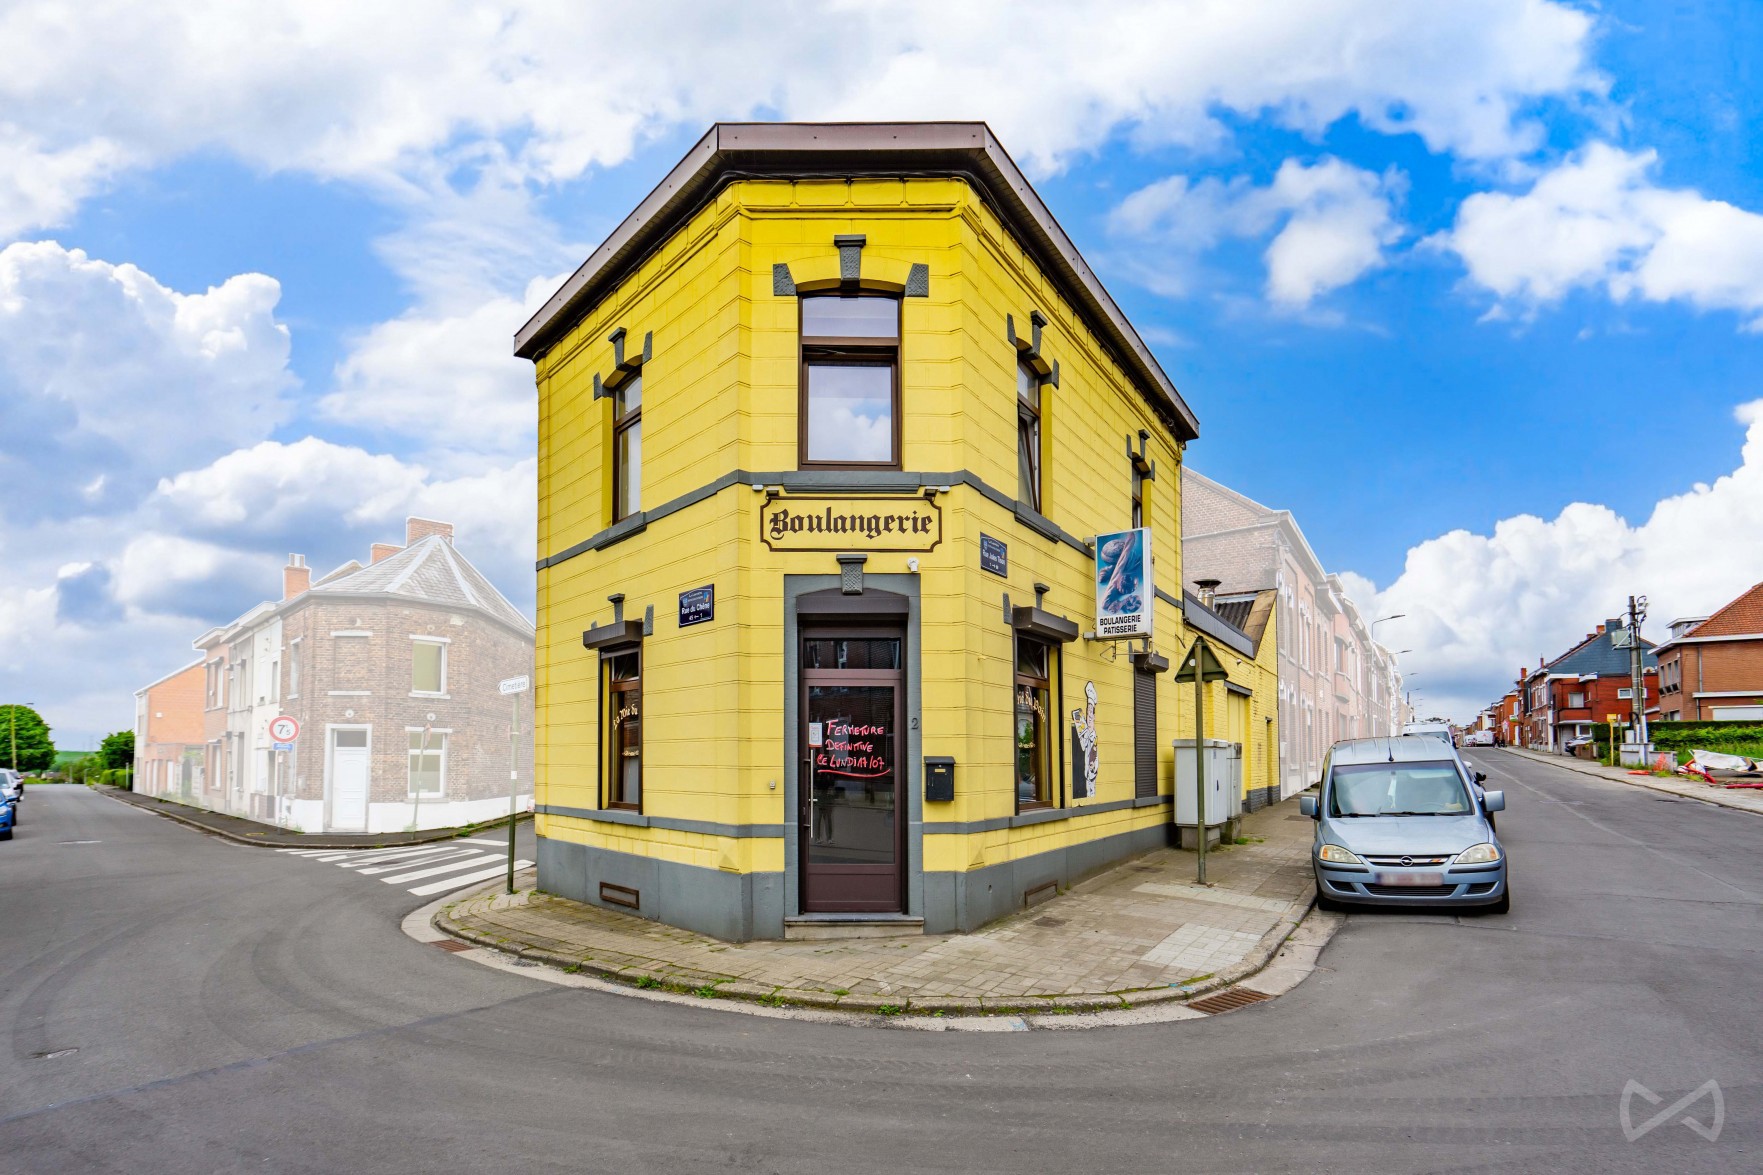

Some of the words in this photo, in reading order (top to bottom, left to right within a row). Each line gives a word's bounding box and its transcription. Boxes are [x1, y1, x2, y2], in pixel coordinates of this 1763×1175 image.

[769, 506, 933, 541] Boulangerie
[681, 607, 690, 615] Rue
[690, 604, 697, 613] du
[1099, 614, 1142, 626] BOULANGERIE
[1103, 624, 1138, 635] PATISSERIE
[825, 719, 884, 736] FERMETURE
[911, 717, 919, 730] 2
[825, 738, 874, 753] DEFINITIVE
